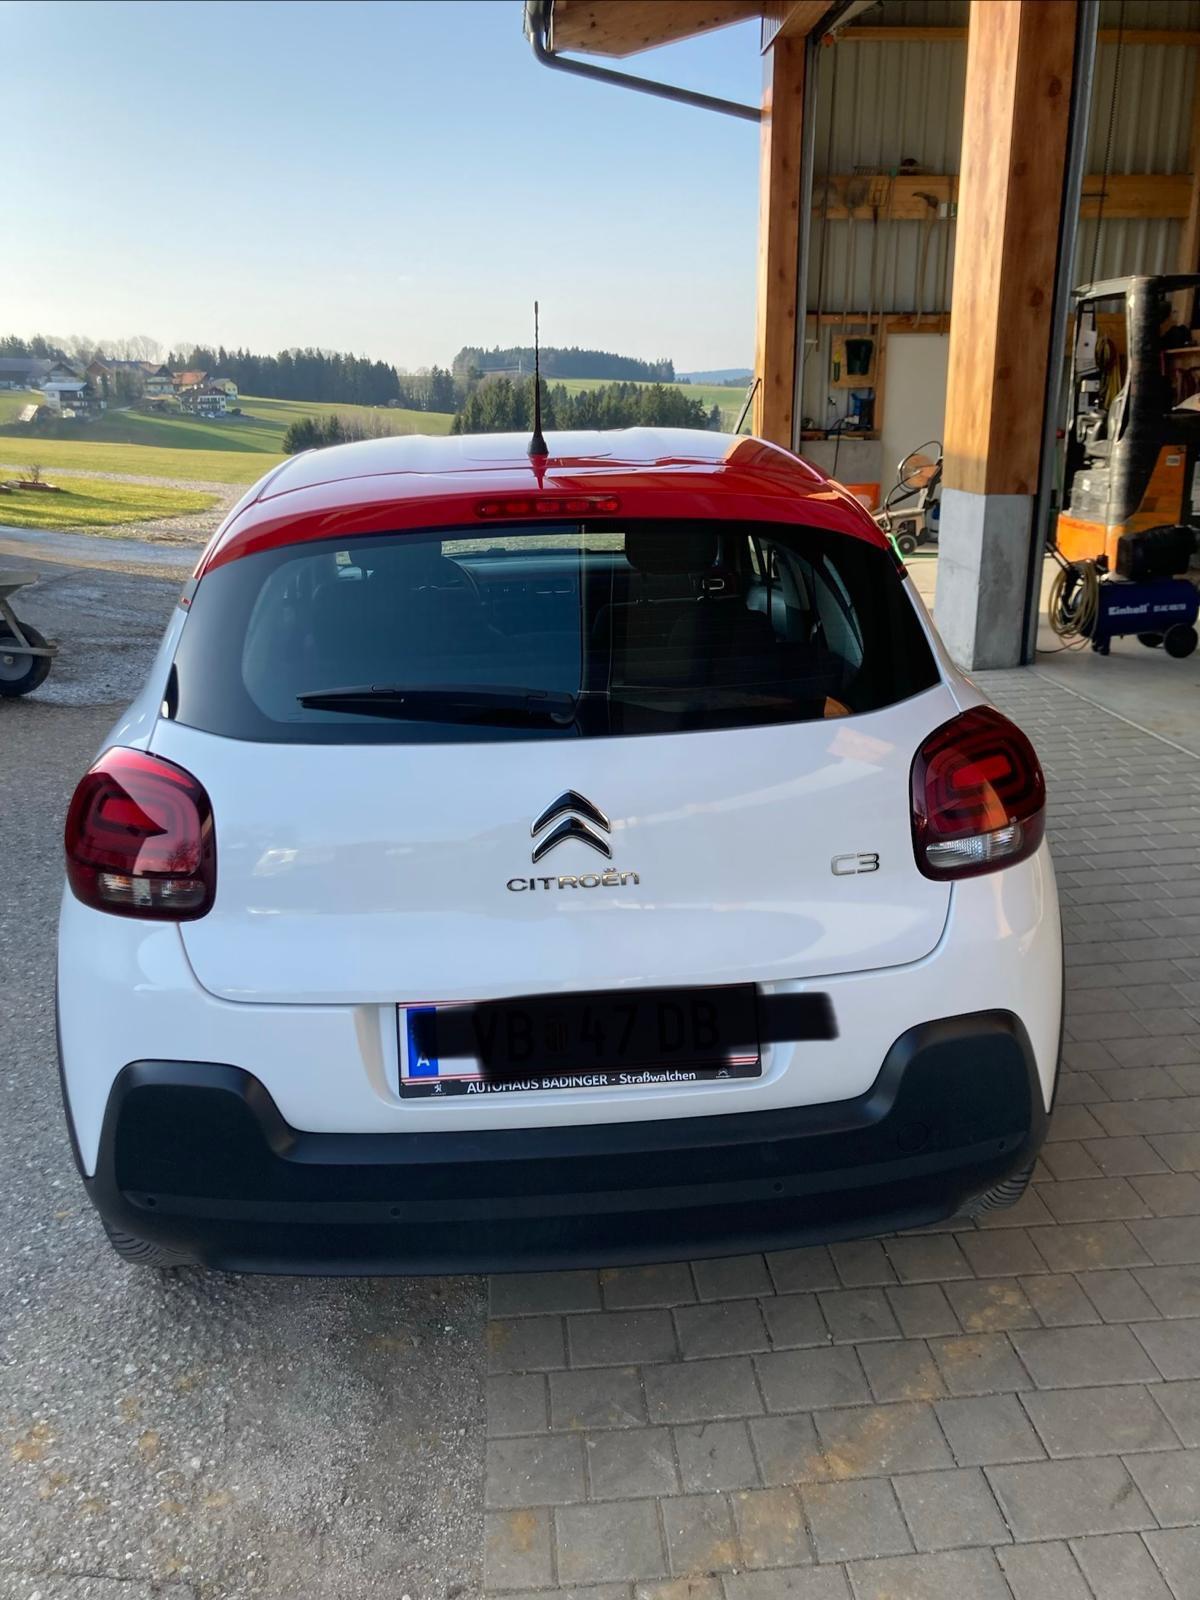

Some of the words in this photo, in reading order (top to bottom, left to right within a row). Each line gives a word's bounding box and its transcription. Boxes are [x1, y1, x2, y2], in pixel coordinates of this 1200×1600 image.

[830, 852, 880, 877] C3
[467, 1077, 539, 1094] AUTOHAUS
[542, 1074, 608, 1089] BADINGER
[619, 1070, 697, 1085] Straßwalchen
